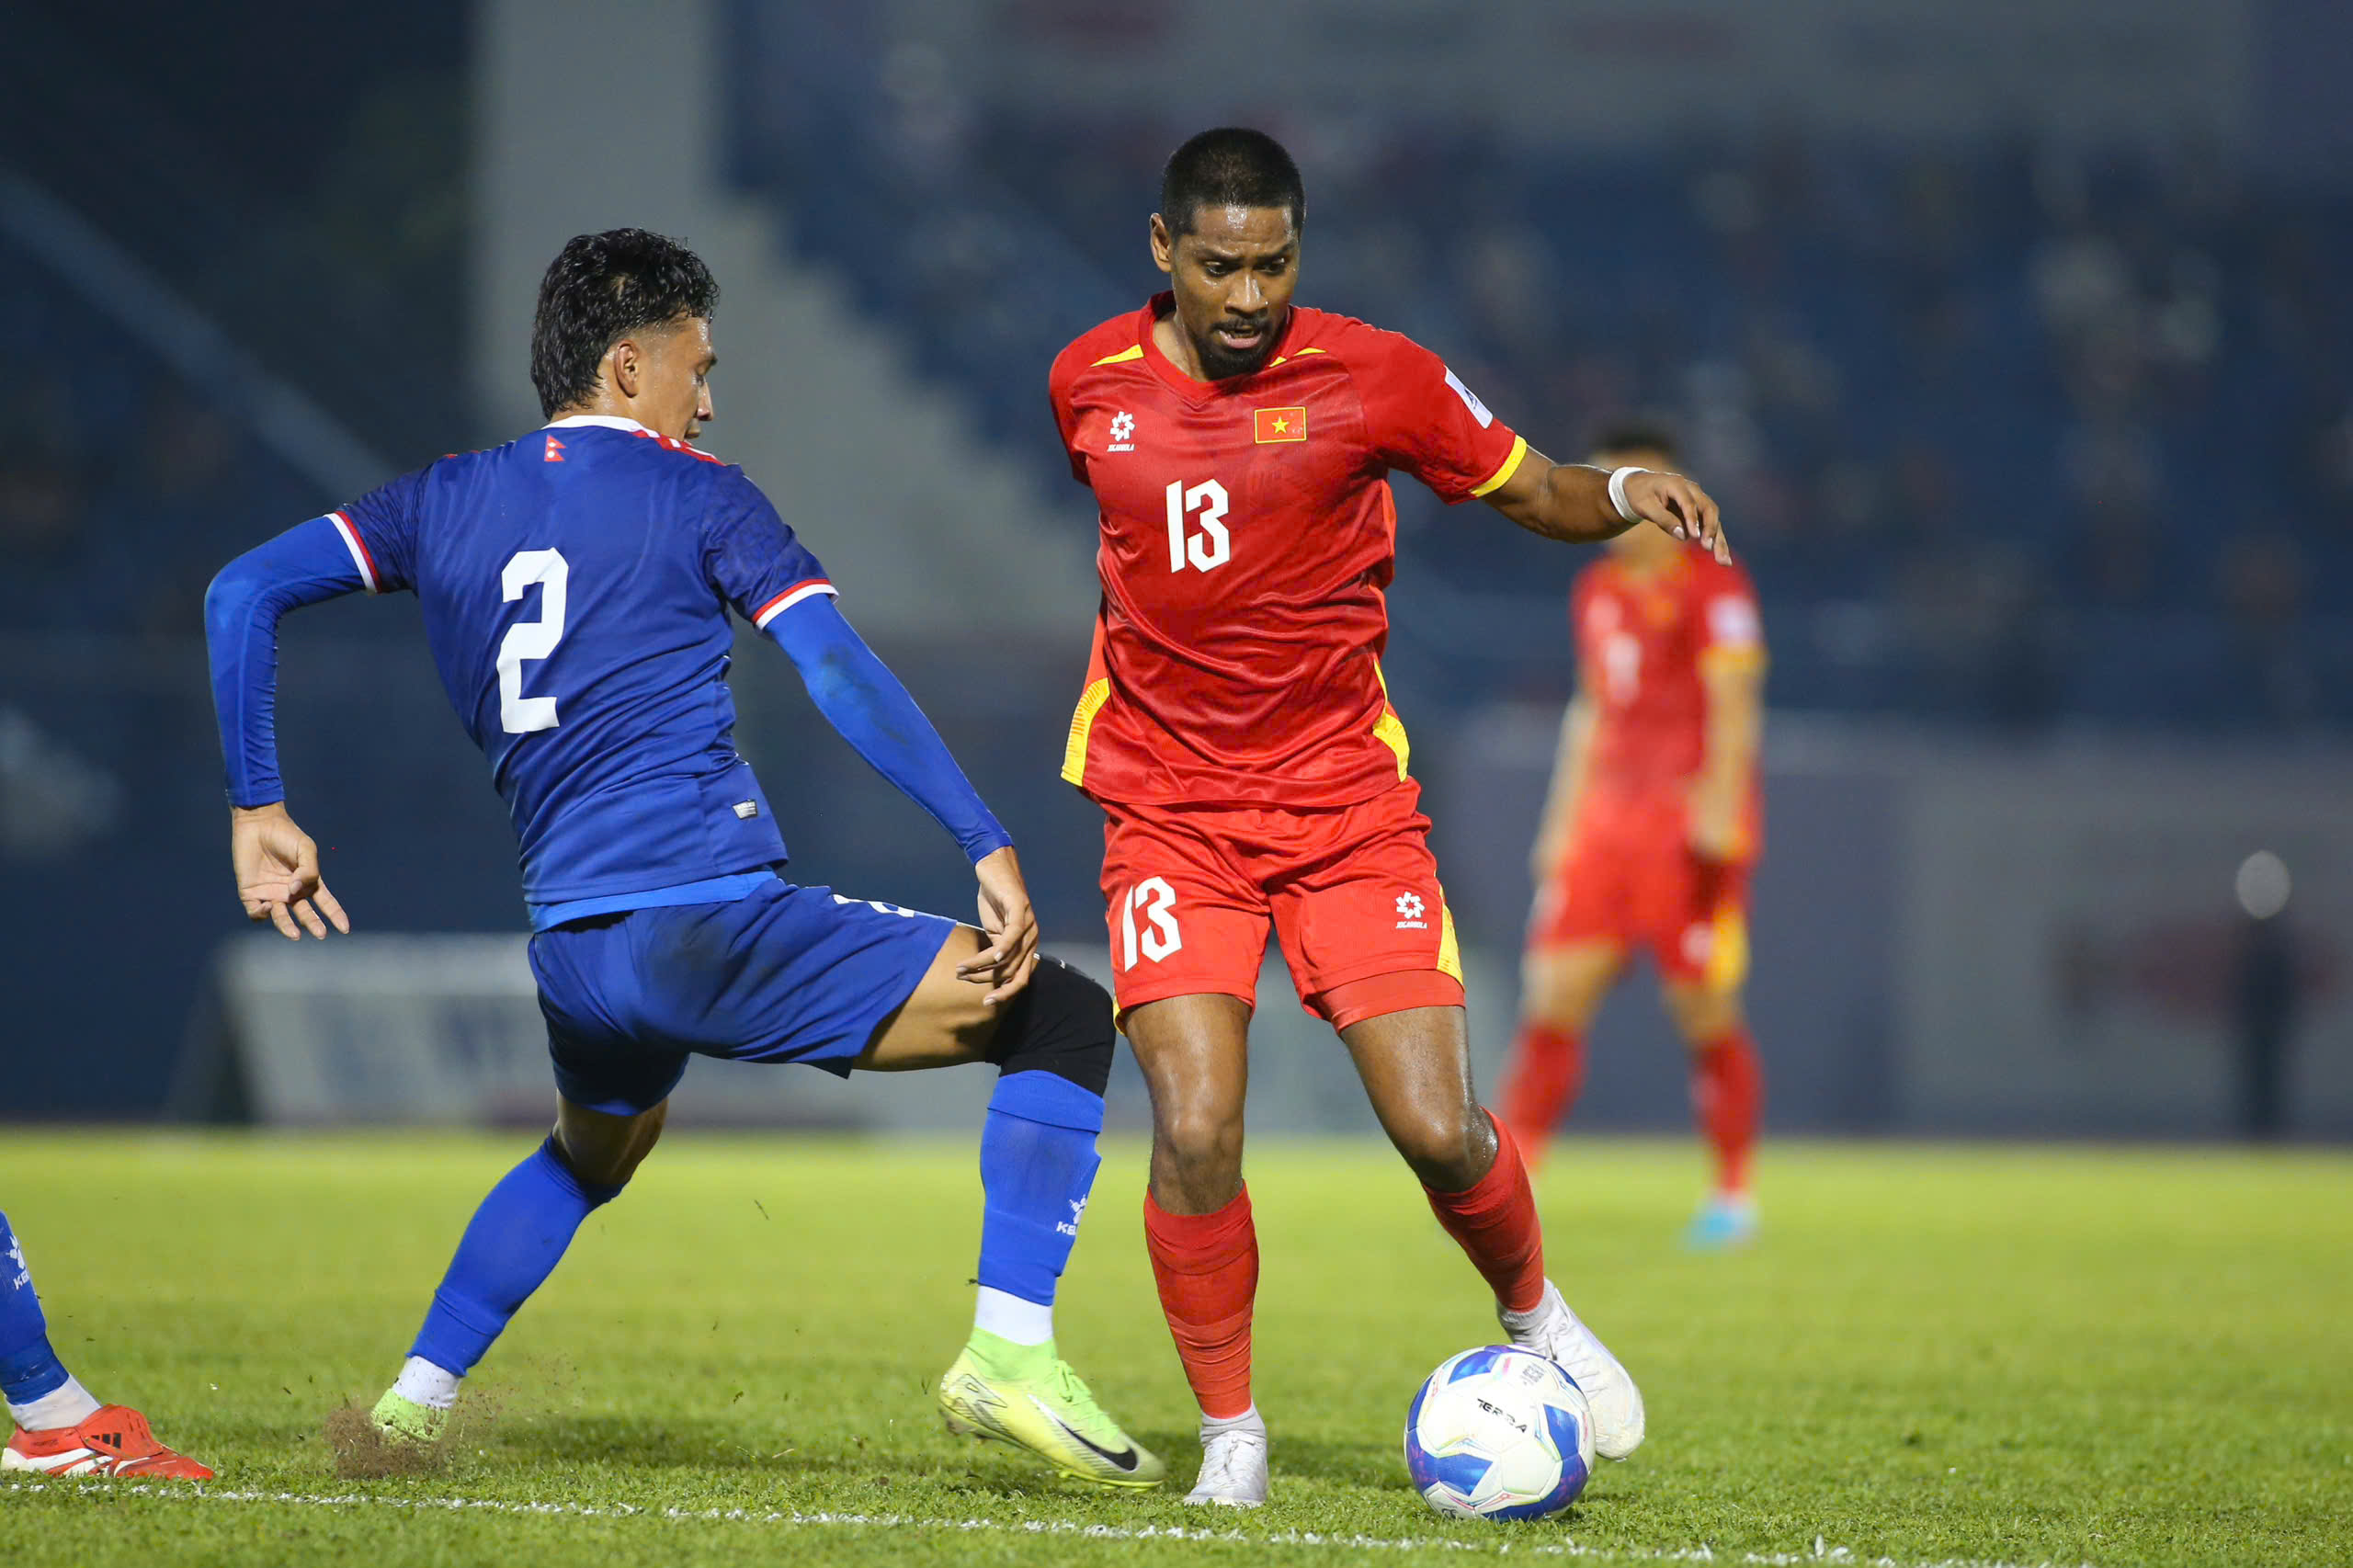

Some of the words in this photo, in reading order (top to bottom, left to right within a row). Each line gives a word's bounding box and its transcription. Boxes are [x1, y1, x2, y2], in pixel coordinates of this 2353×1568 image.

[1165, 478, 1231, 574] 13
[496, 547, 570, 733] 2
[1122, 875, 1183, 972] 13
